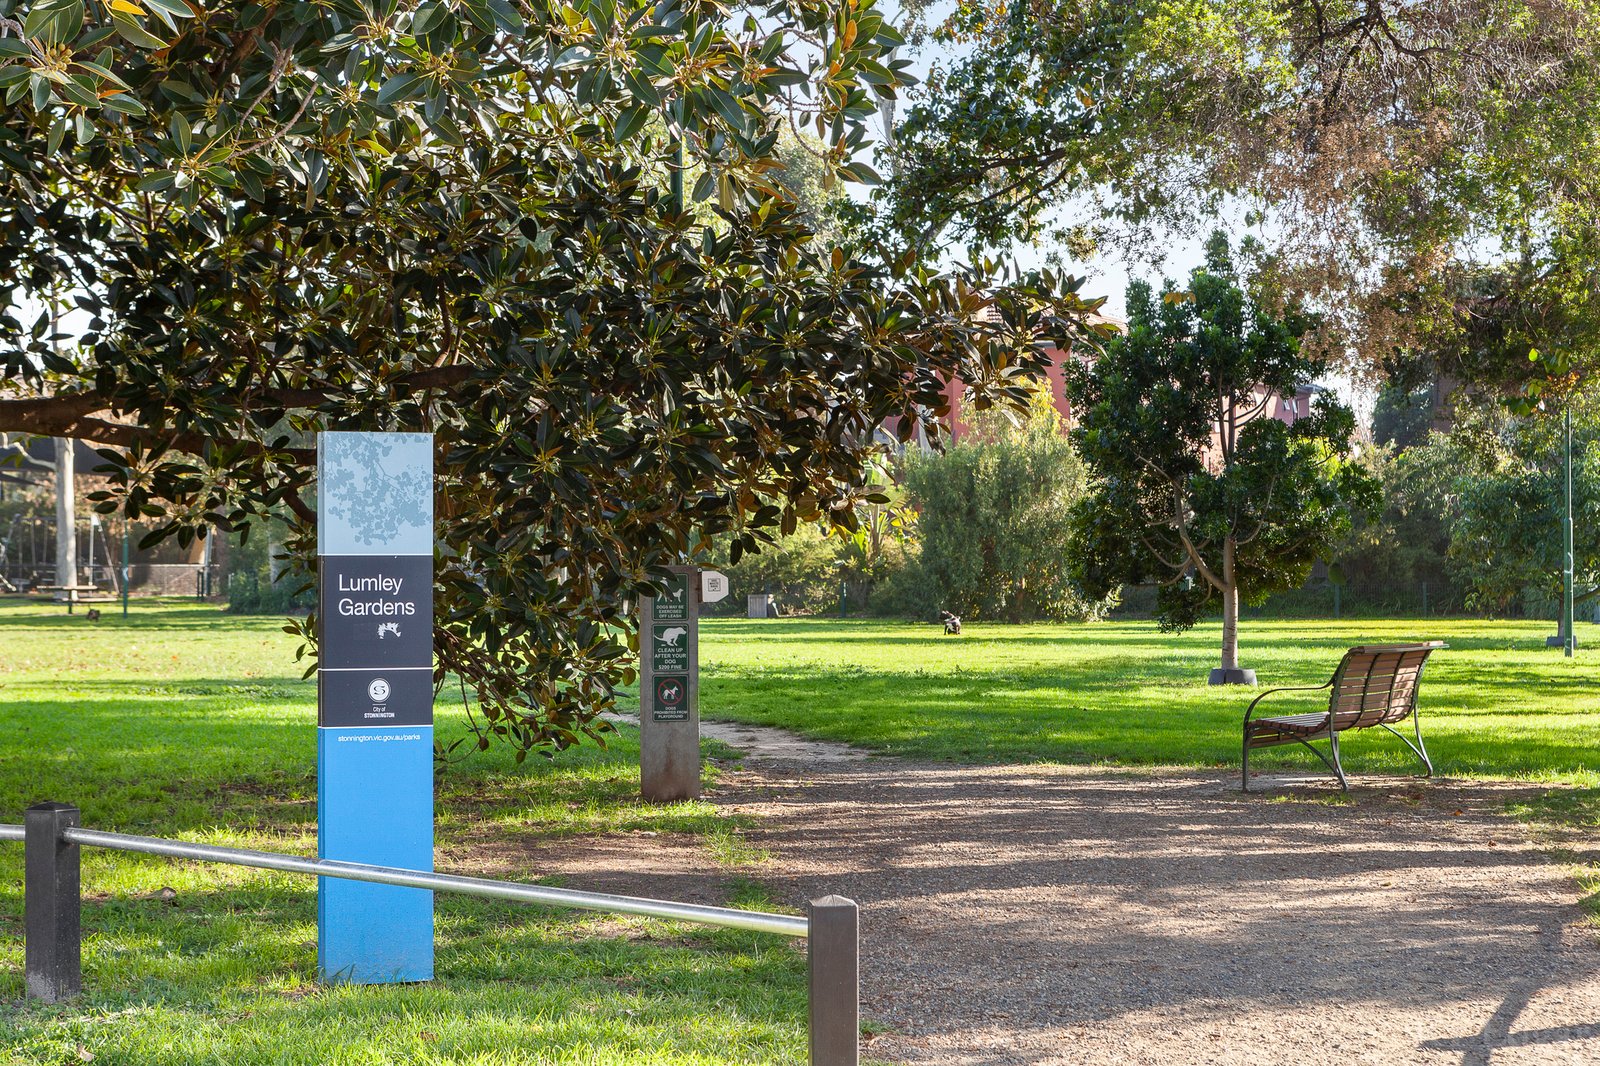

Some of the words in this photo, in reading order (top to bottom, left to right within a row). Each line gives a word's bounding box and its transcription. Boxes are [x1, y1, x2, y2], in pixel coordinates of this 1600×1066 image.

[338, 574, 403, 596] Lumley
[338, 598, 415, 616] Gardens
[338, 734, 420, 742] stonnington.vic.gov.au/parks
